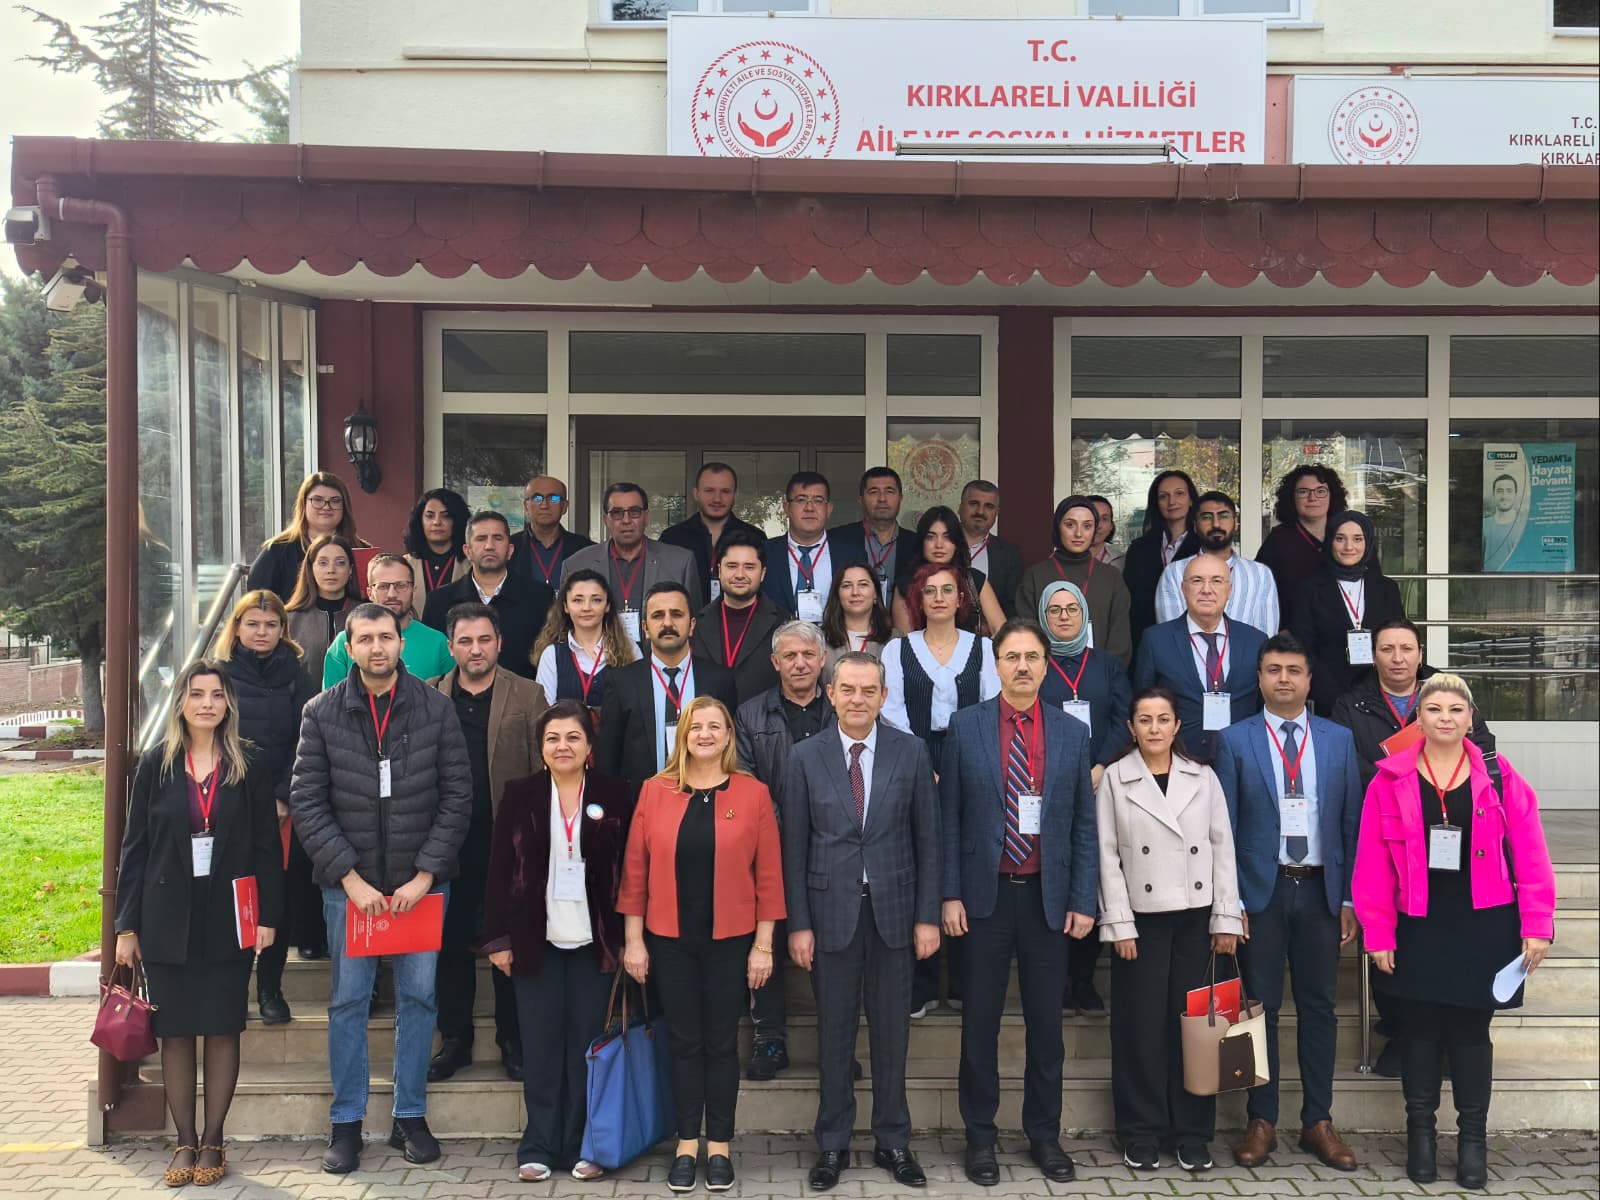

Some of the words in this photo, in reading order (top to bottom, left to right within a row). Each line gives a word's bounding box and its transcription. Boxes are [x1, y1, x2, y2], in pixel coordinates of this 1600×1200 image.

[1027, 40, 1076, 62] T.C.
[738, 70, 754, 84] AİLE
[767, 69, 796, 85] SOSYAL
[908, 81, 1070, 107] KIRKLARELİ
[1077, 81, 1196, 107] VALİLİĞİ
[1571, 116, 1597, 128] T.C.
[1509, 132, 1595, 146] KIRKLARELİ
[1532, 465, 1572, 477] Hayata
[1531, 476, 1571, 486] Devam!
